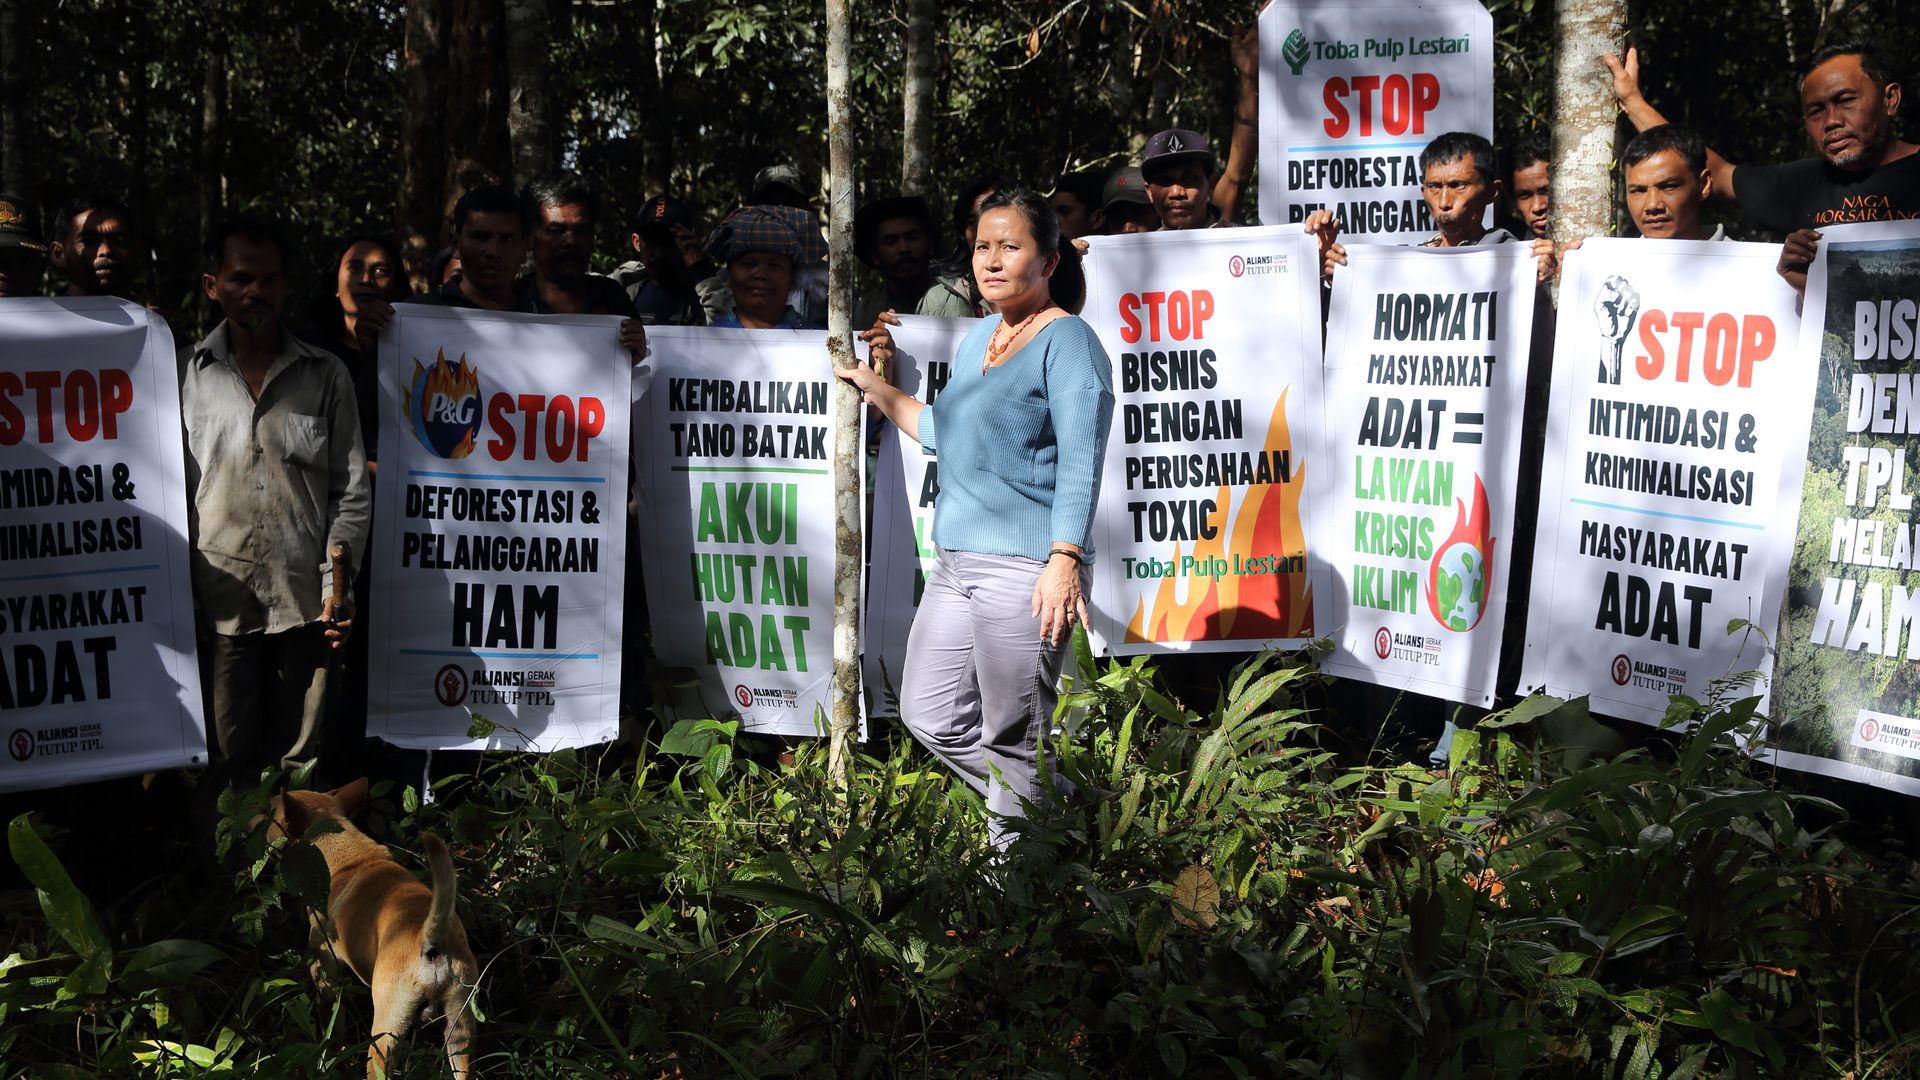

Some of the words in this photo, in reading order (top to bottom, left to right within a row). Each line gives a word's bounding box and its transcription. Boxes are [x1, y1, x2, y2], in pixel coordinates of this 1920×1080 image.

[1314, 40, 1358, 60] Toba
[1364, 38, 1404, 62] Pulp
[1409, 33, 1470, 55] Lestari
[1323, 73, 1440, 139] STOP
[1288, 156, 1426, 191] DEFORESTA
[1288, 200, 1438, 235] PANGGAR
[1842, 195, 1889, 209] NAGA
[1246, 255, 1273, 265] ALIANSI
[1246, 265, 1273, 275] TUTUP
[1273, 265, 1289, 274] TPL
[1118, 289, 1214, 343] STOP
[1373, 290, 1498, 341] HORMATI
[1854, 299, 1920, 361] BIS
[1635, 309, 1776, 388] STOP
[1121, 349, 1217, 393] BISNIS
[1367, 354, 1496, 387] MASYARAKAT
[0, 369, 133, 446] STOP
[426, 392, 477, 425] P&G
[669, 378, 828, 415] KEMBALIKAN
[487, 392, 605, 463] STOP
[670, 423, 735, 457] TANO
[742, 425, 827, 460] BATAK
[1124, 399, 1242, 444] DENGAN
[1358, 397, 1446, 450] ADAT
[1588, 398, 1728, 450] INTIMIDASI
[1735, 413, 1758, 454] &
[0, 464, 104, 509] MIDASI
[112, 462, 137, 501] &
[1126, 450, 1290, 490] PERUSAHAAN
[1355, 455, 1454, 506] LAWAN
[1584, 451, 1754, 506] KRIMINALISASI
[1843, 446, 1913, 510] TPL
[405, 484, 573, 524] DEFORESTASI
[580, 491, 601, 525] &
[697, 482, 798, 545] AKUI
[1128, 499, 1217, 542] TOXIC
[402, 532, 598, 573] PELANGGARAN
[1354, 511, 1434, 560] KRISIS
[1579, 520, 1748, 581] MASYARAKAT
[690, 552, 808, 607] HUTAN
[1122, 557, 1175, 580] Toba
[1181, 554, 1227, 582] Pulp
[1233, 551, 1303, 576] Lestari
[1352, 564, 1418, 615] IKLIM
[451, 582, 559, 650] HAM
[1595, 571, 1712, 650] ADAT
[1810, 577, 1920, 660] HAM
[706, 611, 811, 672] ADAT
[1393, 647, 1422, 663] TUTUP
[1423, 652, 1440, 666] TPL
[1394, 632, 1425, 649] ALIANSI
[472, 670, 525, 687] ALIANSI
[527, 671, 555, 680] GERAK
[1632, 675, 1665, 692] TUTUP
[1633, 661, 1668, 679] ALIANSI
[1668, 667, 1687, 678] GERAK
[470, 689, 522, 705] TUTUP
[525, 691, 556, 706] TPL
[753, 688, 783, 698] ALIANSI
[755, 697, 783, 708] TUTUP
[37, 726, 78, 742] ALIANSI
[37, 741, 78, 756] TUTUP
[80, 738, 104, 752] TPL
[1879, 733, 1908, 747] TUTUP
[1908, 739, 1920, 750] TP
[1881, 723, 1911, 737] ALIANSI
